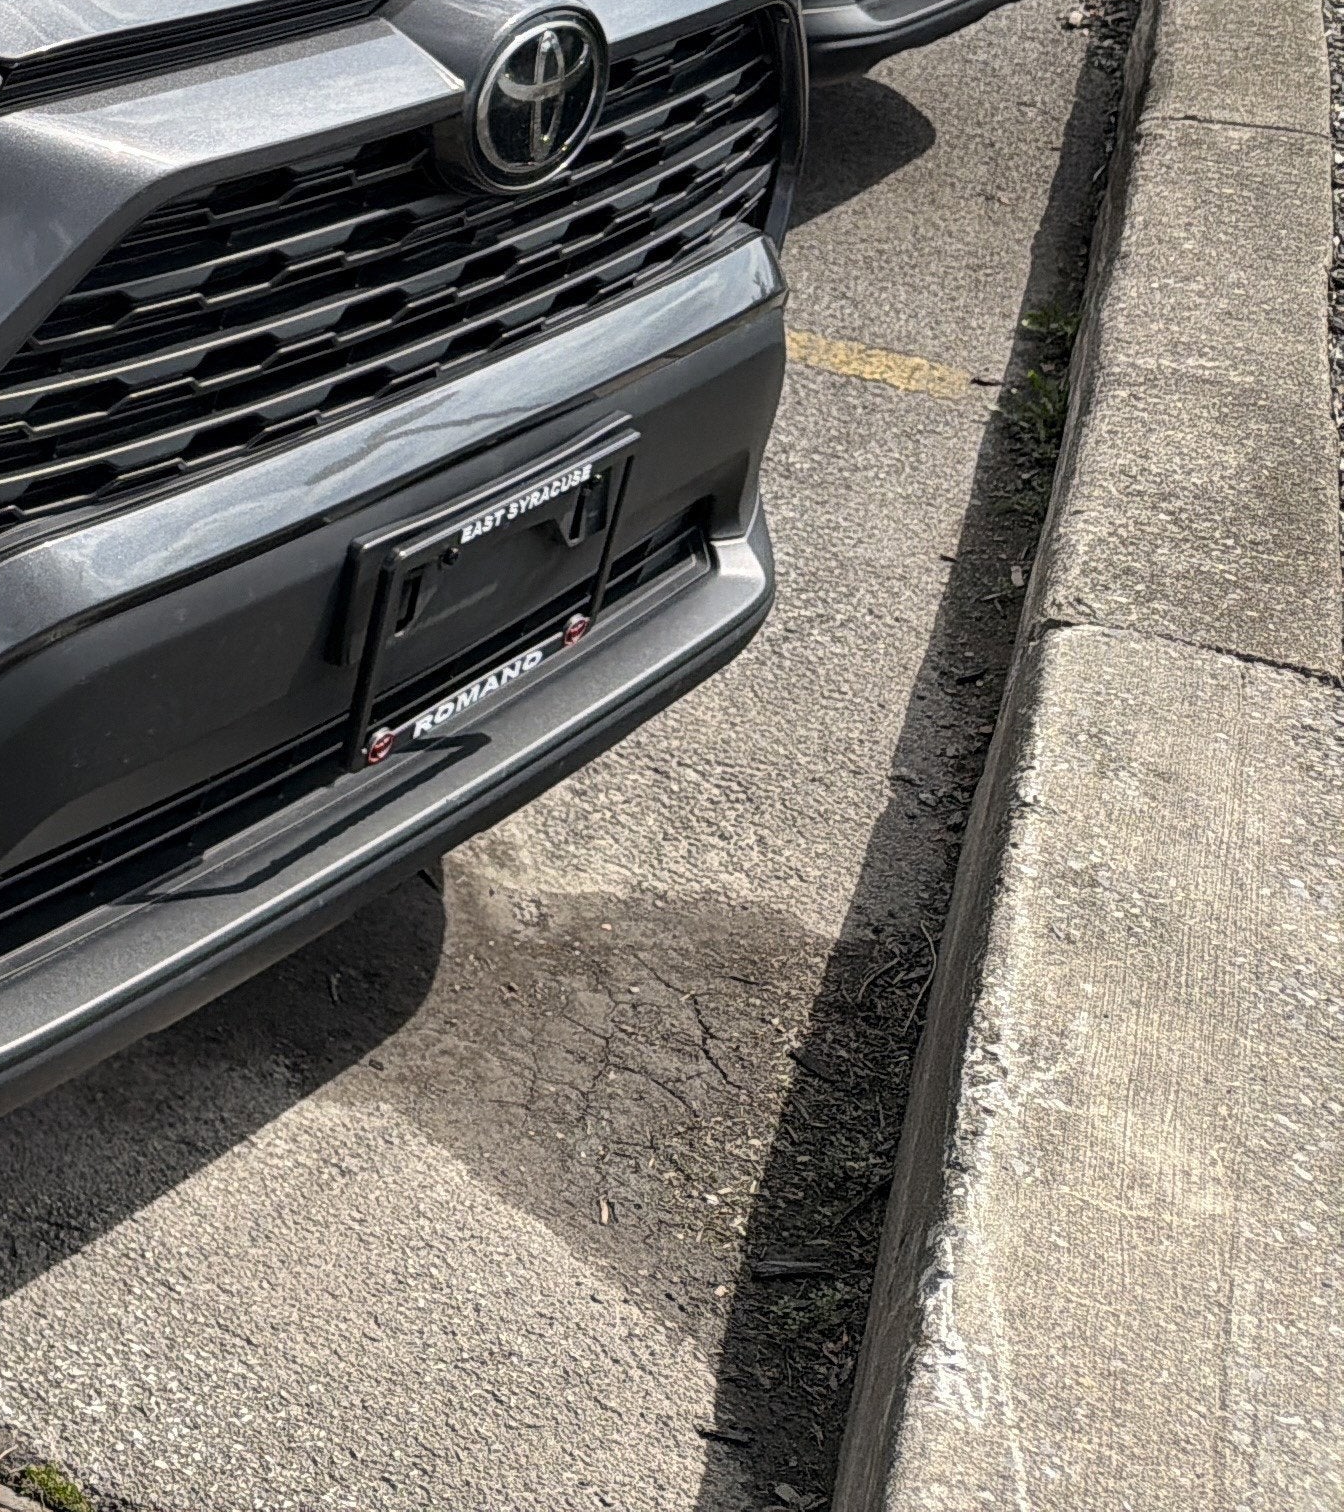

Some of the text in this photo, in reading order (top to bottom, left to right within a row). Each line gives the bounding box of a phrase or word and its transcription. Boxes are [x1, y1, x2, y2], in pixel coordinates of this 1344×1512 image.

[459, 463, 594, 544] EAST SYRACUSE
[411, 649, 544, 740] ROMANO
